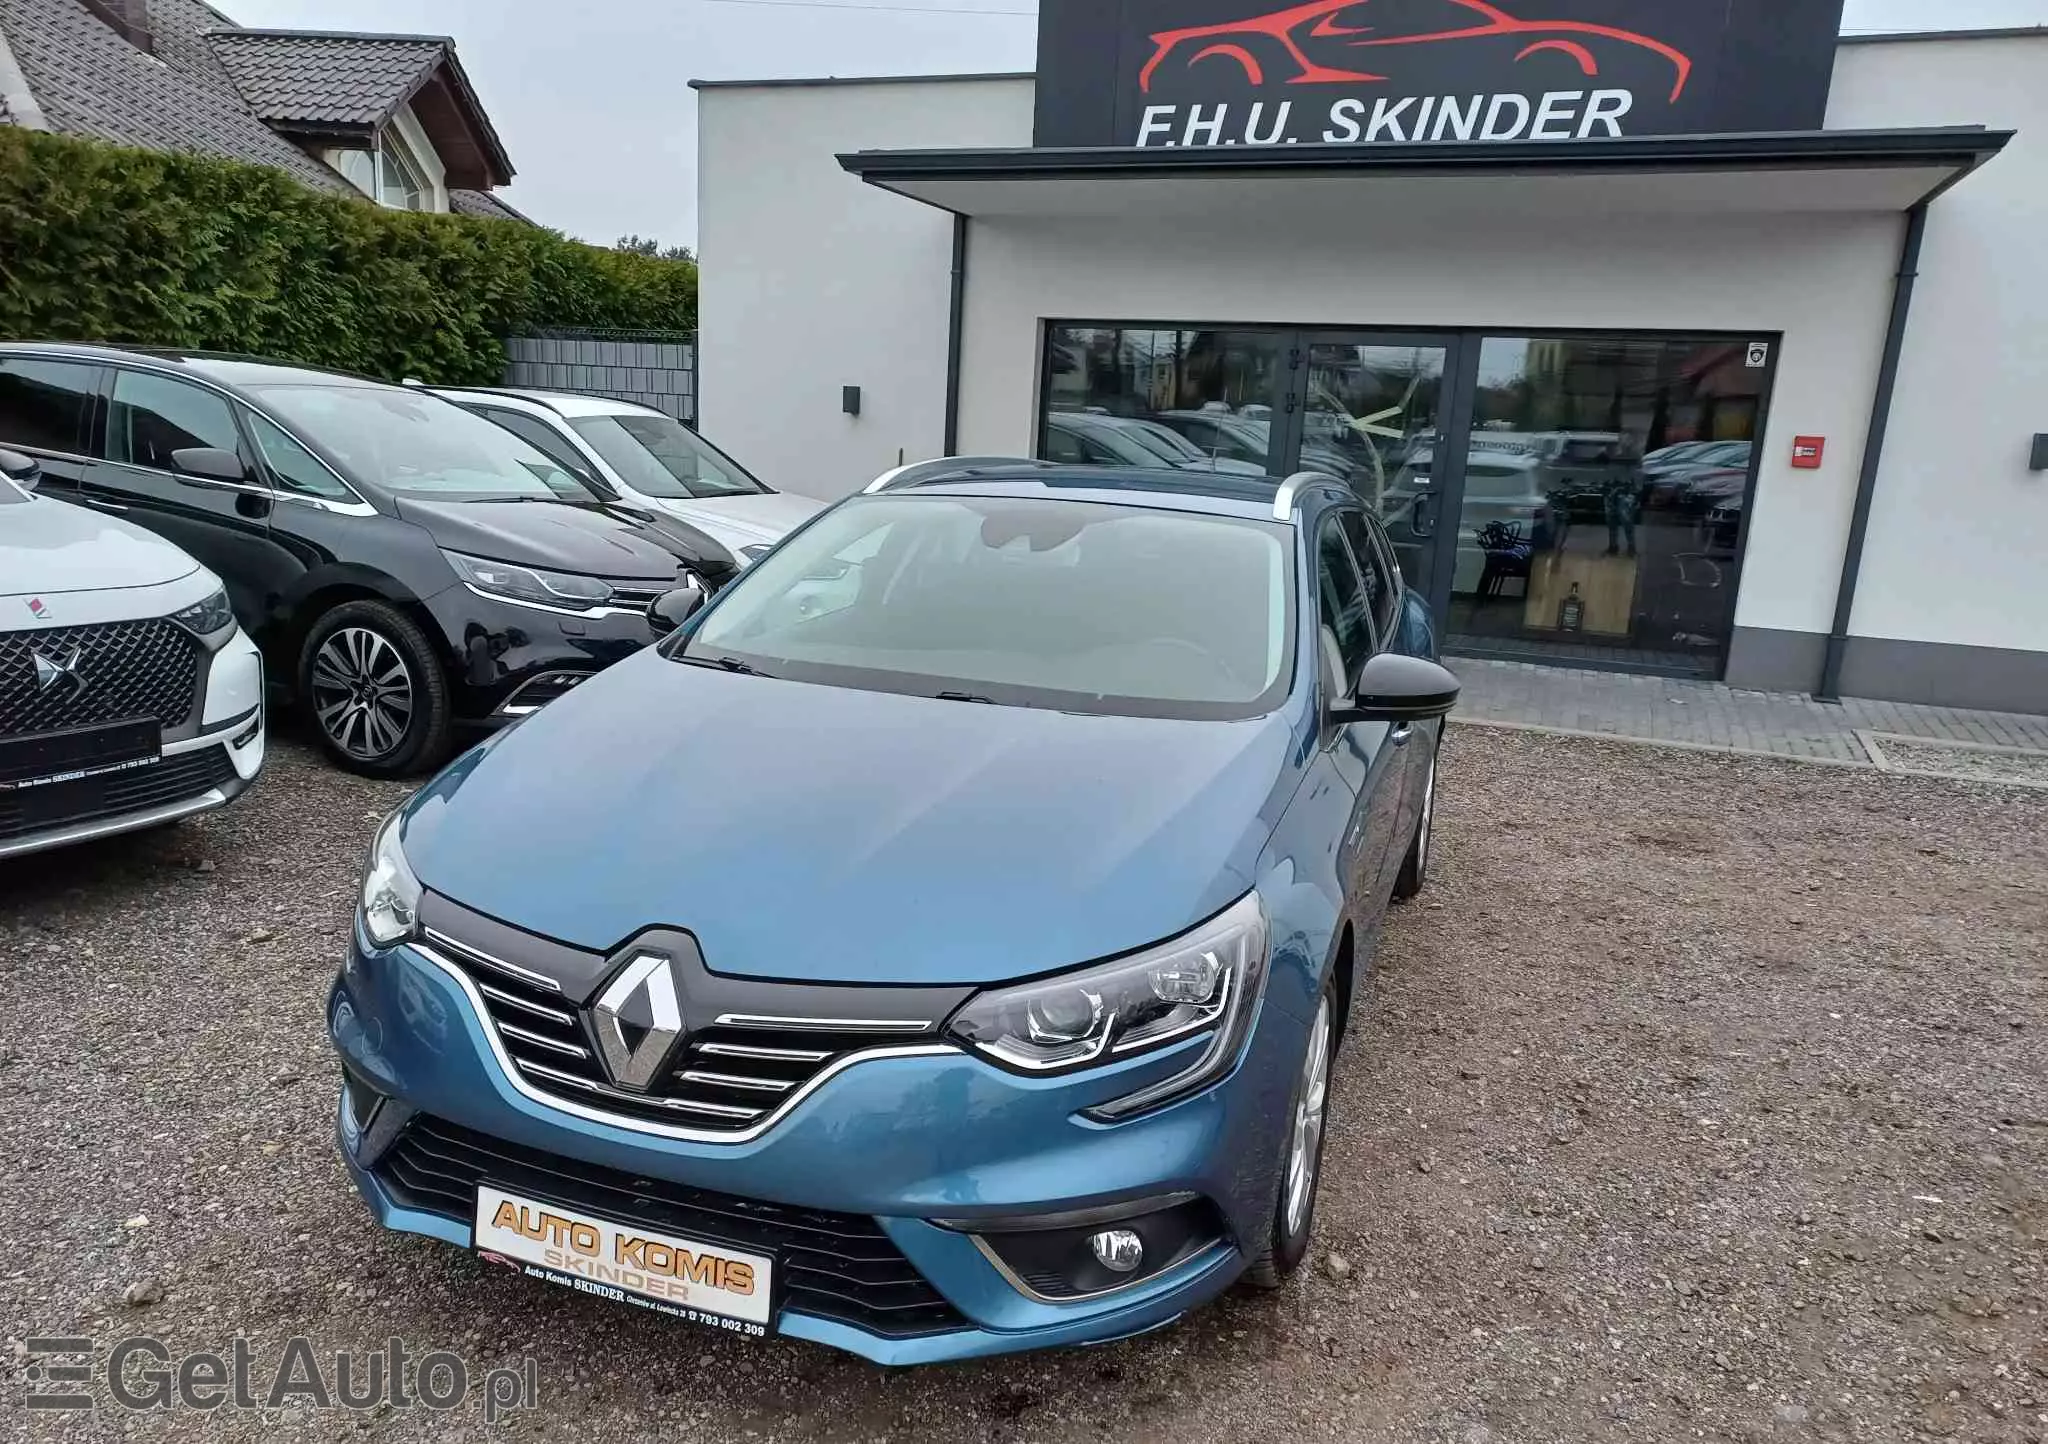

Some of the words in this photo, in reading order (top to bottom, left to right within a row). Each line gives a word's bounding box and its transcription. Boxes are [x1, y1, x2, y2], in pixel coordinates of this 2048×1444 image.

[1136, 101, 1298, 147] F.H.U.
[1322, 88, 1633, 142] SKINDER
[491, 1200, 601, 1256] AUTO
[615, 1233, 755, 1296] KOMIS
[543, 1248, 689, 1301] SKINDER
[524, 1265, 544, 1279] Auto
[545, 1272, 572, 1287] Komis
[574, 1279, 625, 1302] SKINDER
[699, 1313, 718, 1326] 793
[721, 1318, 742, 1332] 002
